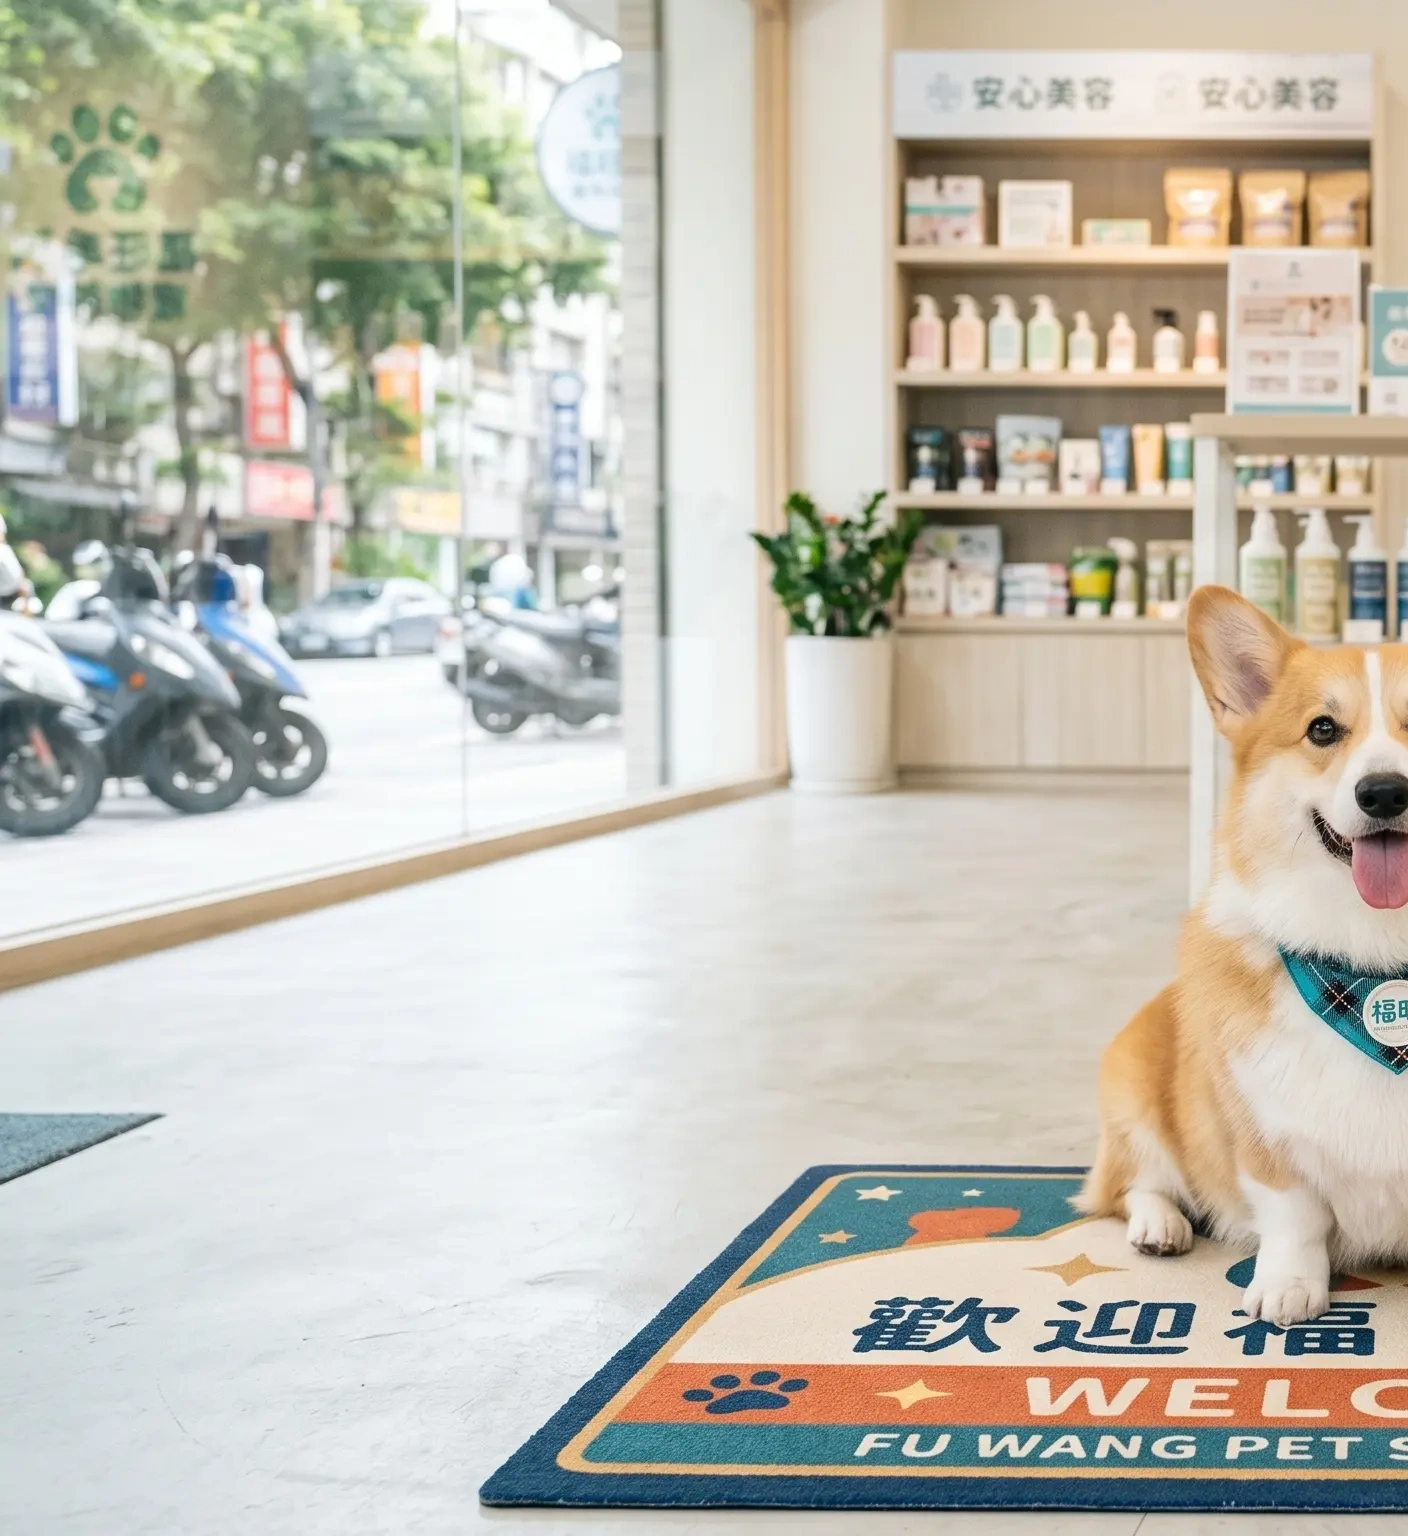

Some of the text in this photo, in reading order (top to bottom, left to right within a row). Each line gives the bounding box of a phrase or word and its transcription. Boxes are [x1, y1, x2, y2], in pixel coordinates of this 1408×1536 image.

[973, 76, 1341, 111] 安心美容 安心美容
[853, 1433, 952, 1459] FU
[977, 1434, 1198, 1460] WANG
[1224, 1436, 1364, 1461] PET
